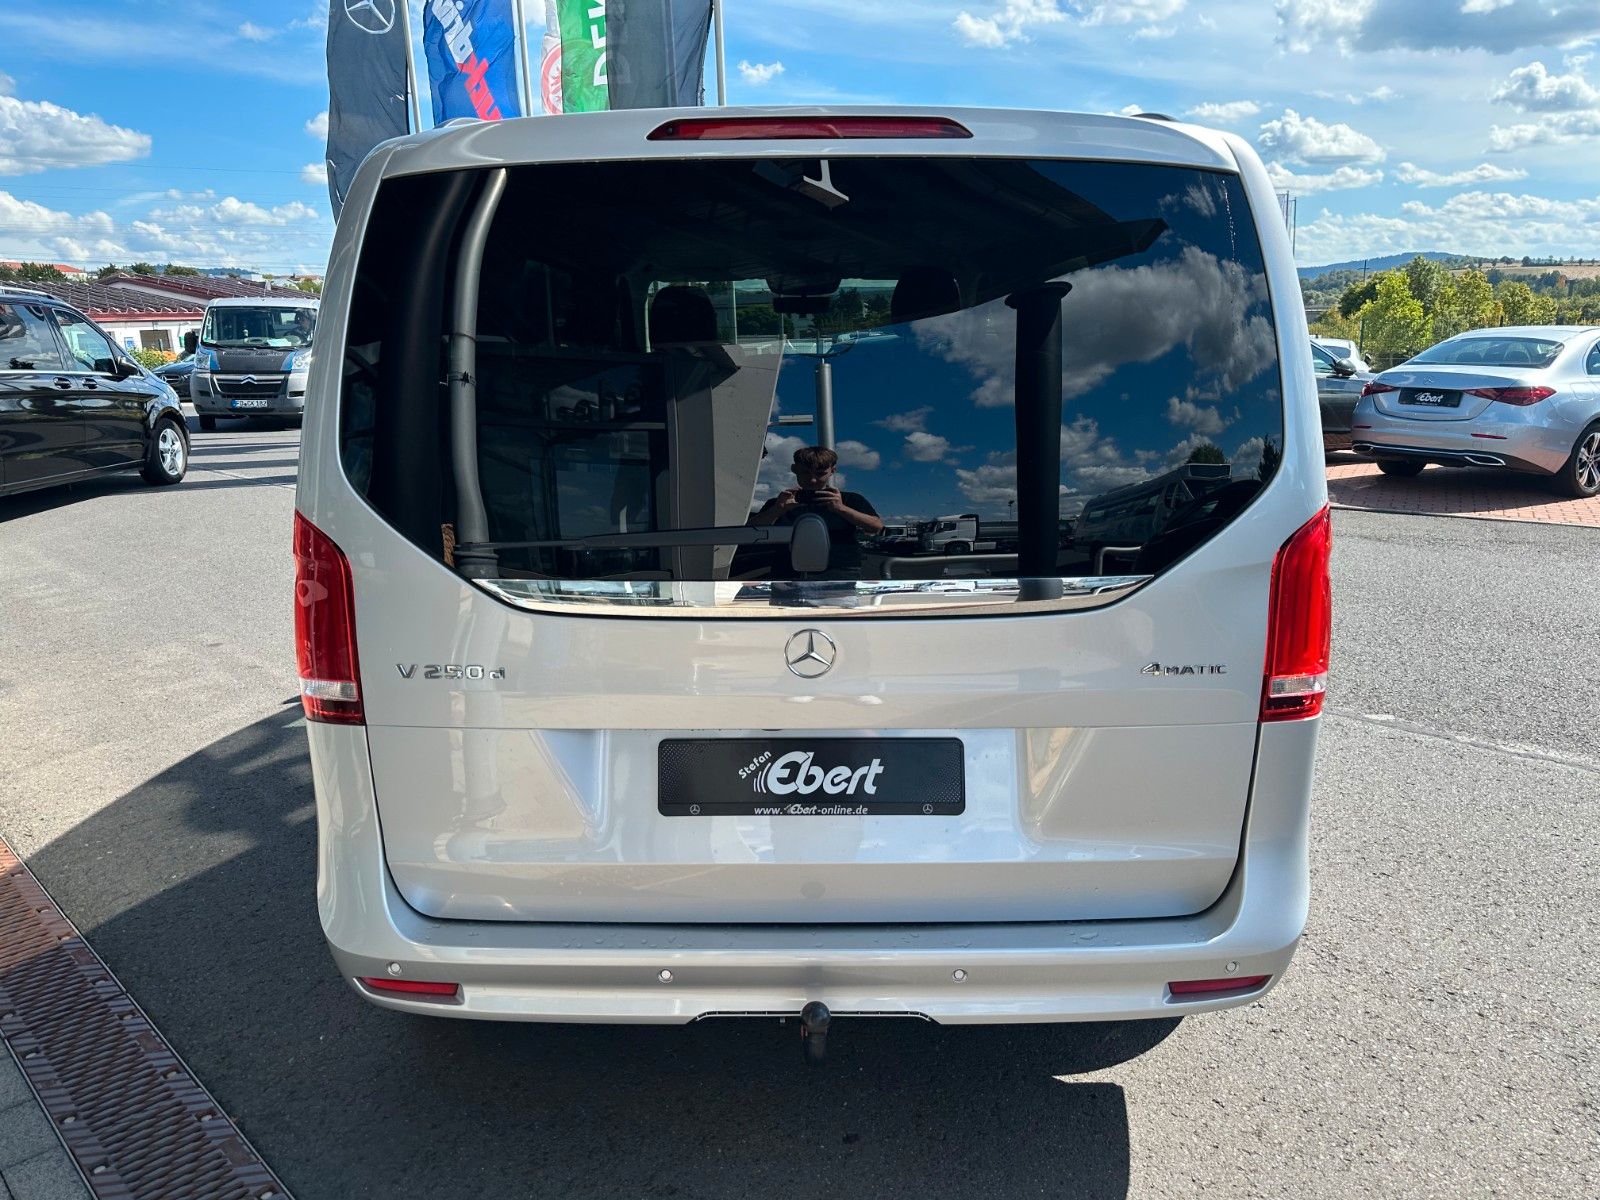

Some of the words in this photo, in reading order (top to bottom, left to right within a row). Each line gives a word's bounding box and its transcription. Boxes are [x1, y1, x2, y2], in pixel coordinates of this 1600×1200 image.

[1141, 662, 1227, 676] 4MATIC
[738, 751, 772, 779] Stefan
[766, 750, 884, 795] Ebert
